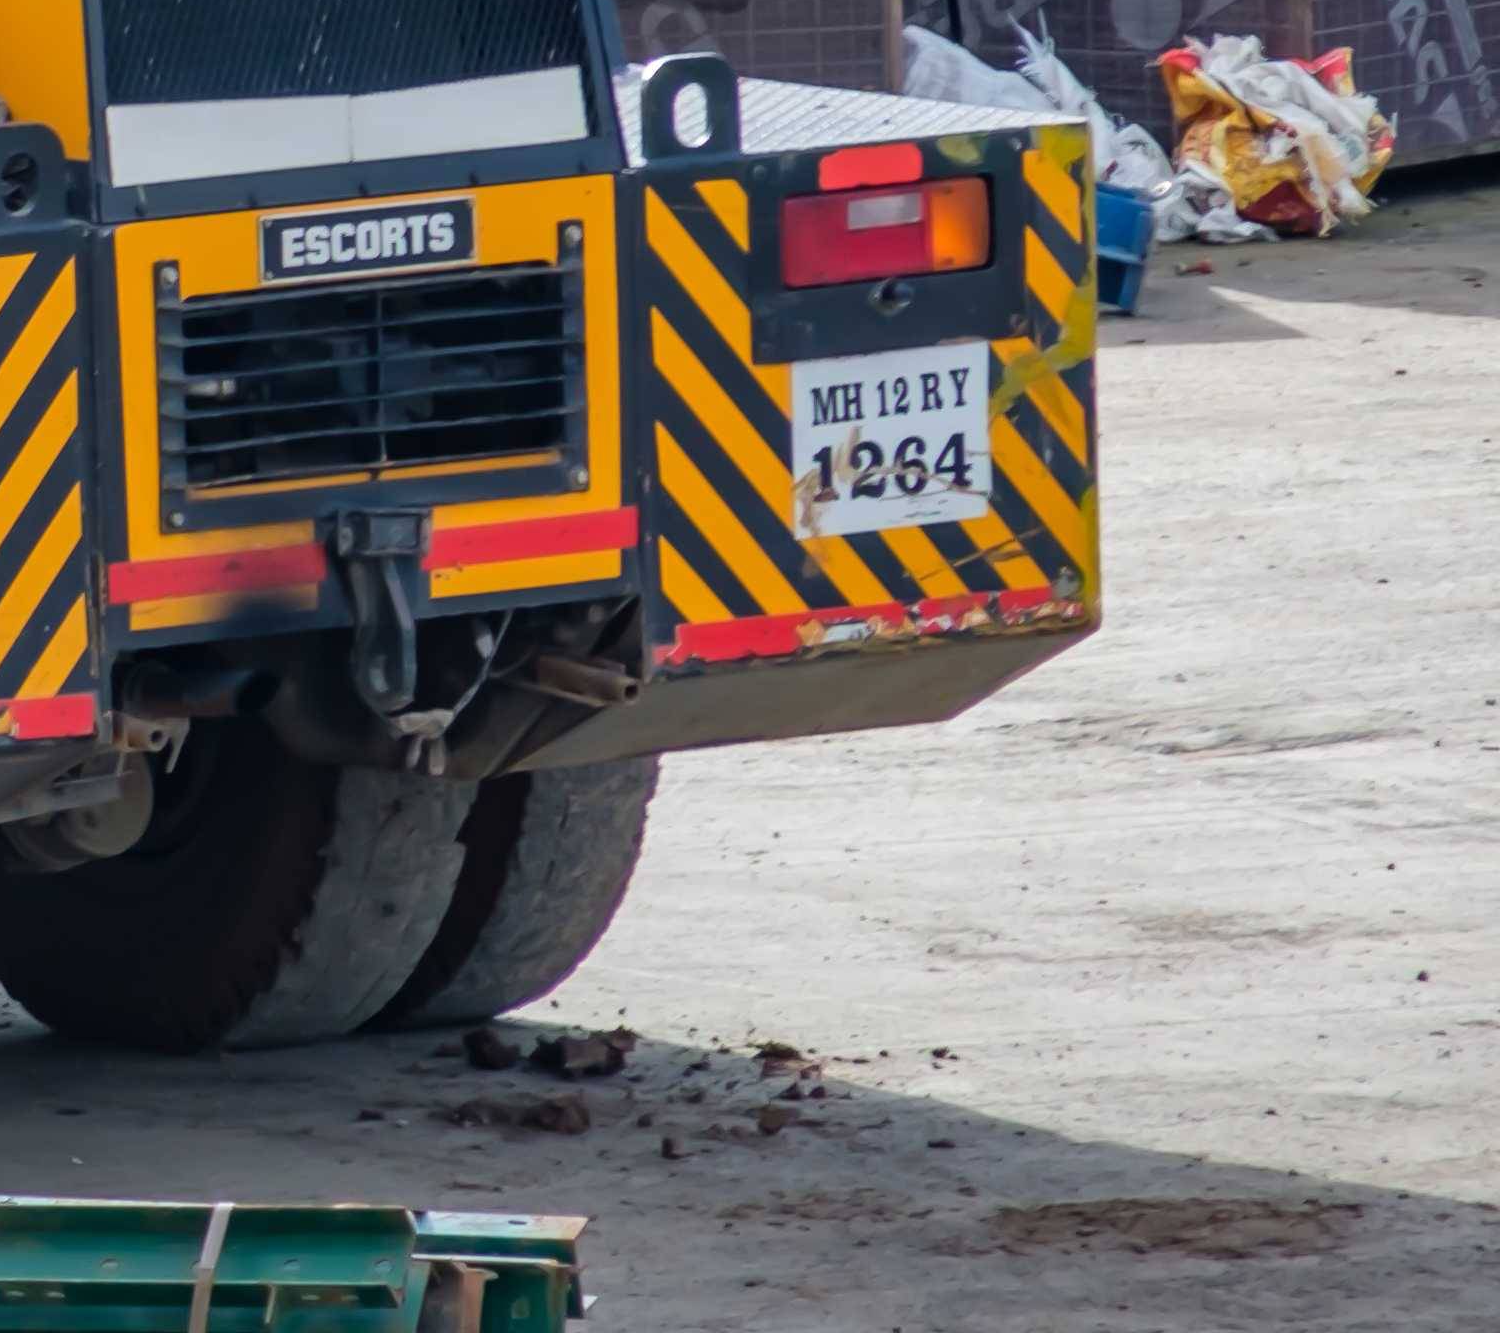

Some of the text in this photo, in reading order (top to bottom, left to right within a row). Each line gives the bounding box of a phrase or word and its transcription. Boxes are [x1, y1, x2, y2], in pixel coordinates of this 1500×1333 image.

[282, 212, 455, 268] ESCORTS
[811, 382, 864, 425] MH
[877, 377, 911, 417] 12
[813, 433, 973, 502] 1264
